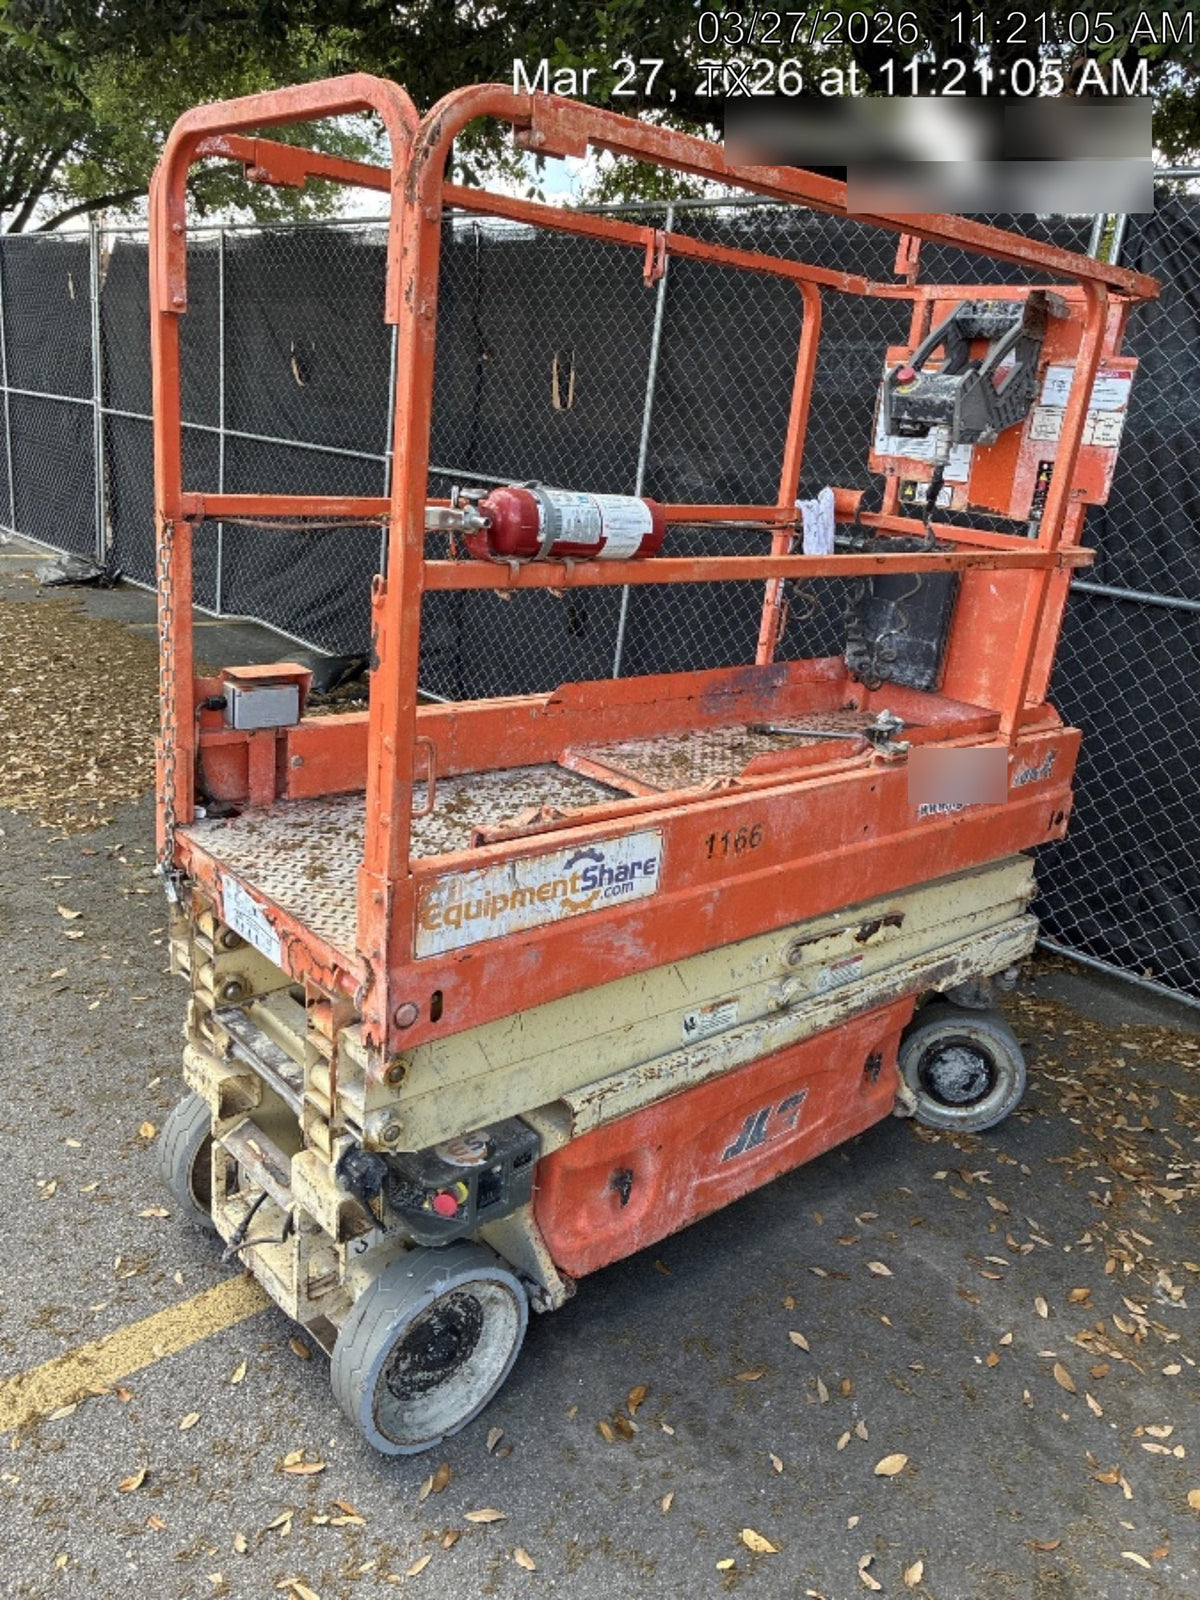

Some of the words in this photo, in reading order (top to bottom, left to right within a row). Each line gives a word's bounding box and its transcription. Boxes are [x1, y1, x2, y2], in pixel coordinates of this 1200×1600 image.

[705, 824, 763, 859] 1166
[421, 857, 657, 931] EquipmentShare
[600, 880, 634, 901] .com
